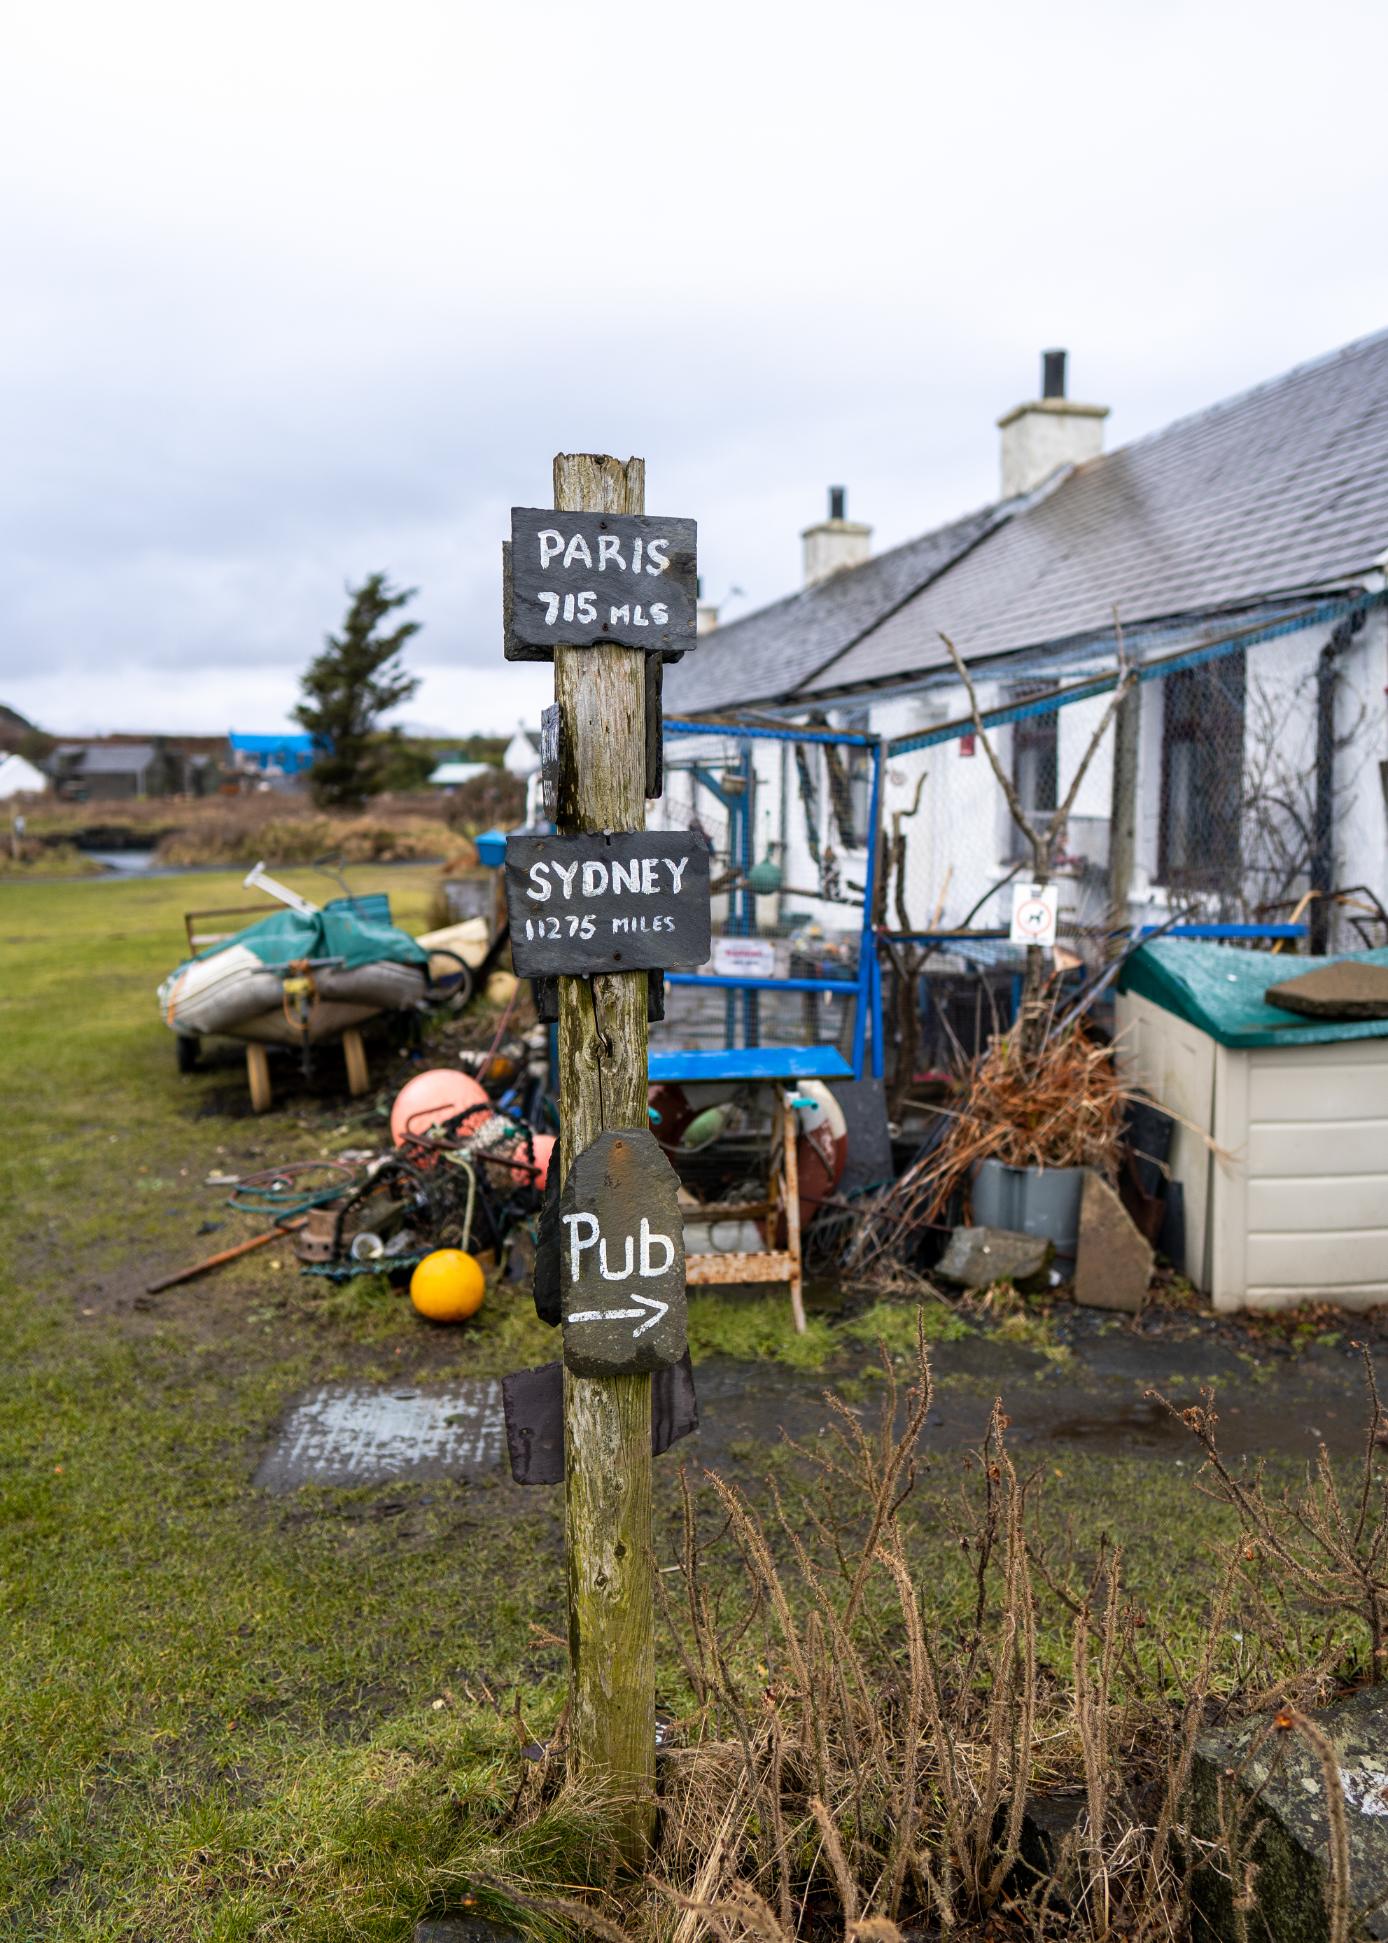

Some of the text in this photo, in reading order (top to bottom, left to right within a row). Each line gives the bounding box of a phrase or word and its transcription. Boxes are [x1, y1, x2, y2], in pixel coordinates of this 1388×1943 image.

[538, 529, 670, 576] PARIS
[537, 591, 669, 627] 715 MLS
[526, 856, 689, 901] SYDNEY
[525, 914, 676, 940] 11275 MILES
[562, 1212, 675, 1282] Pub
